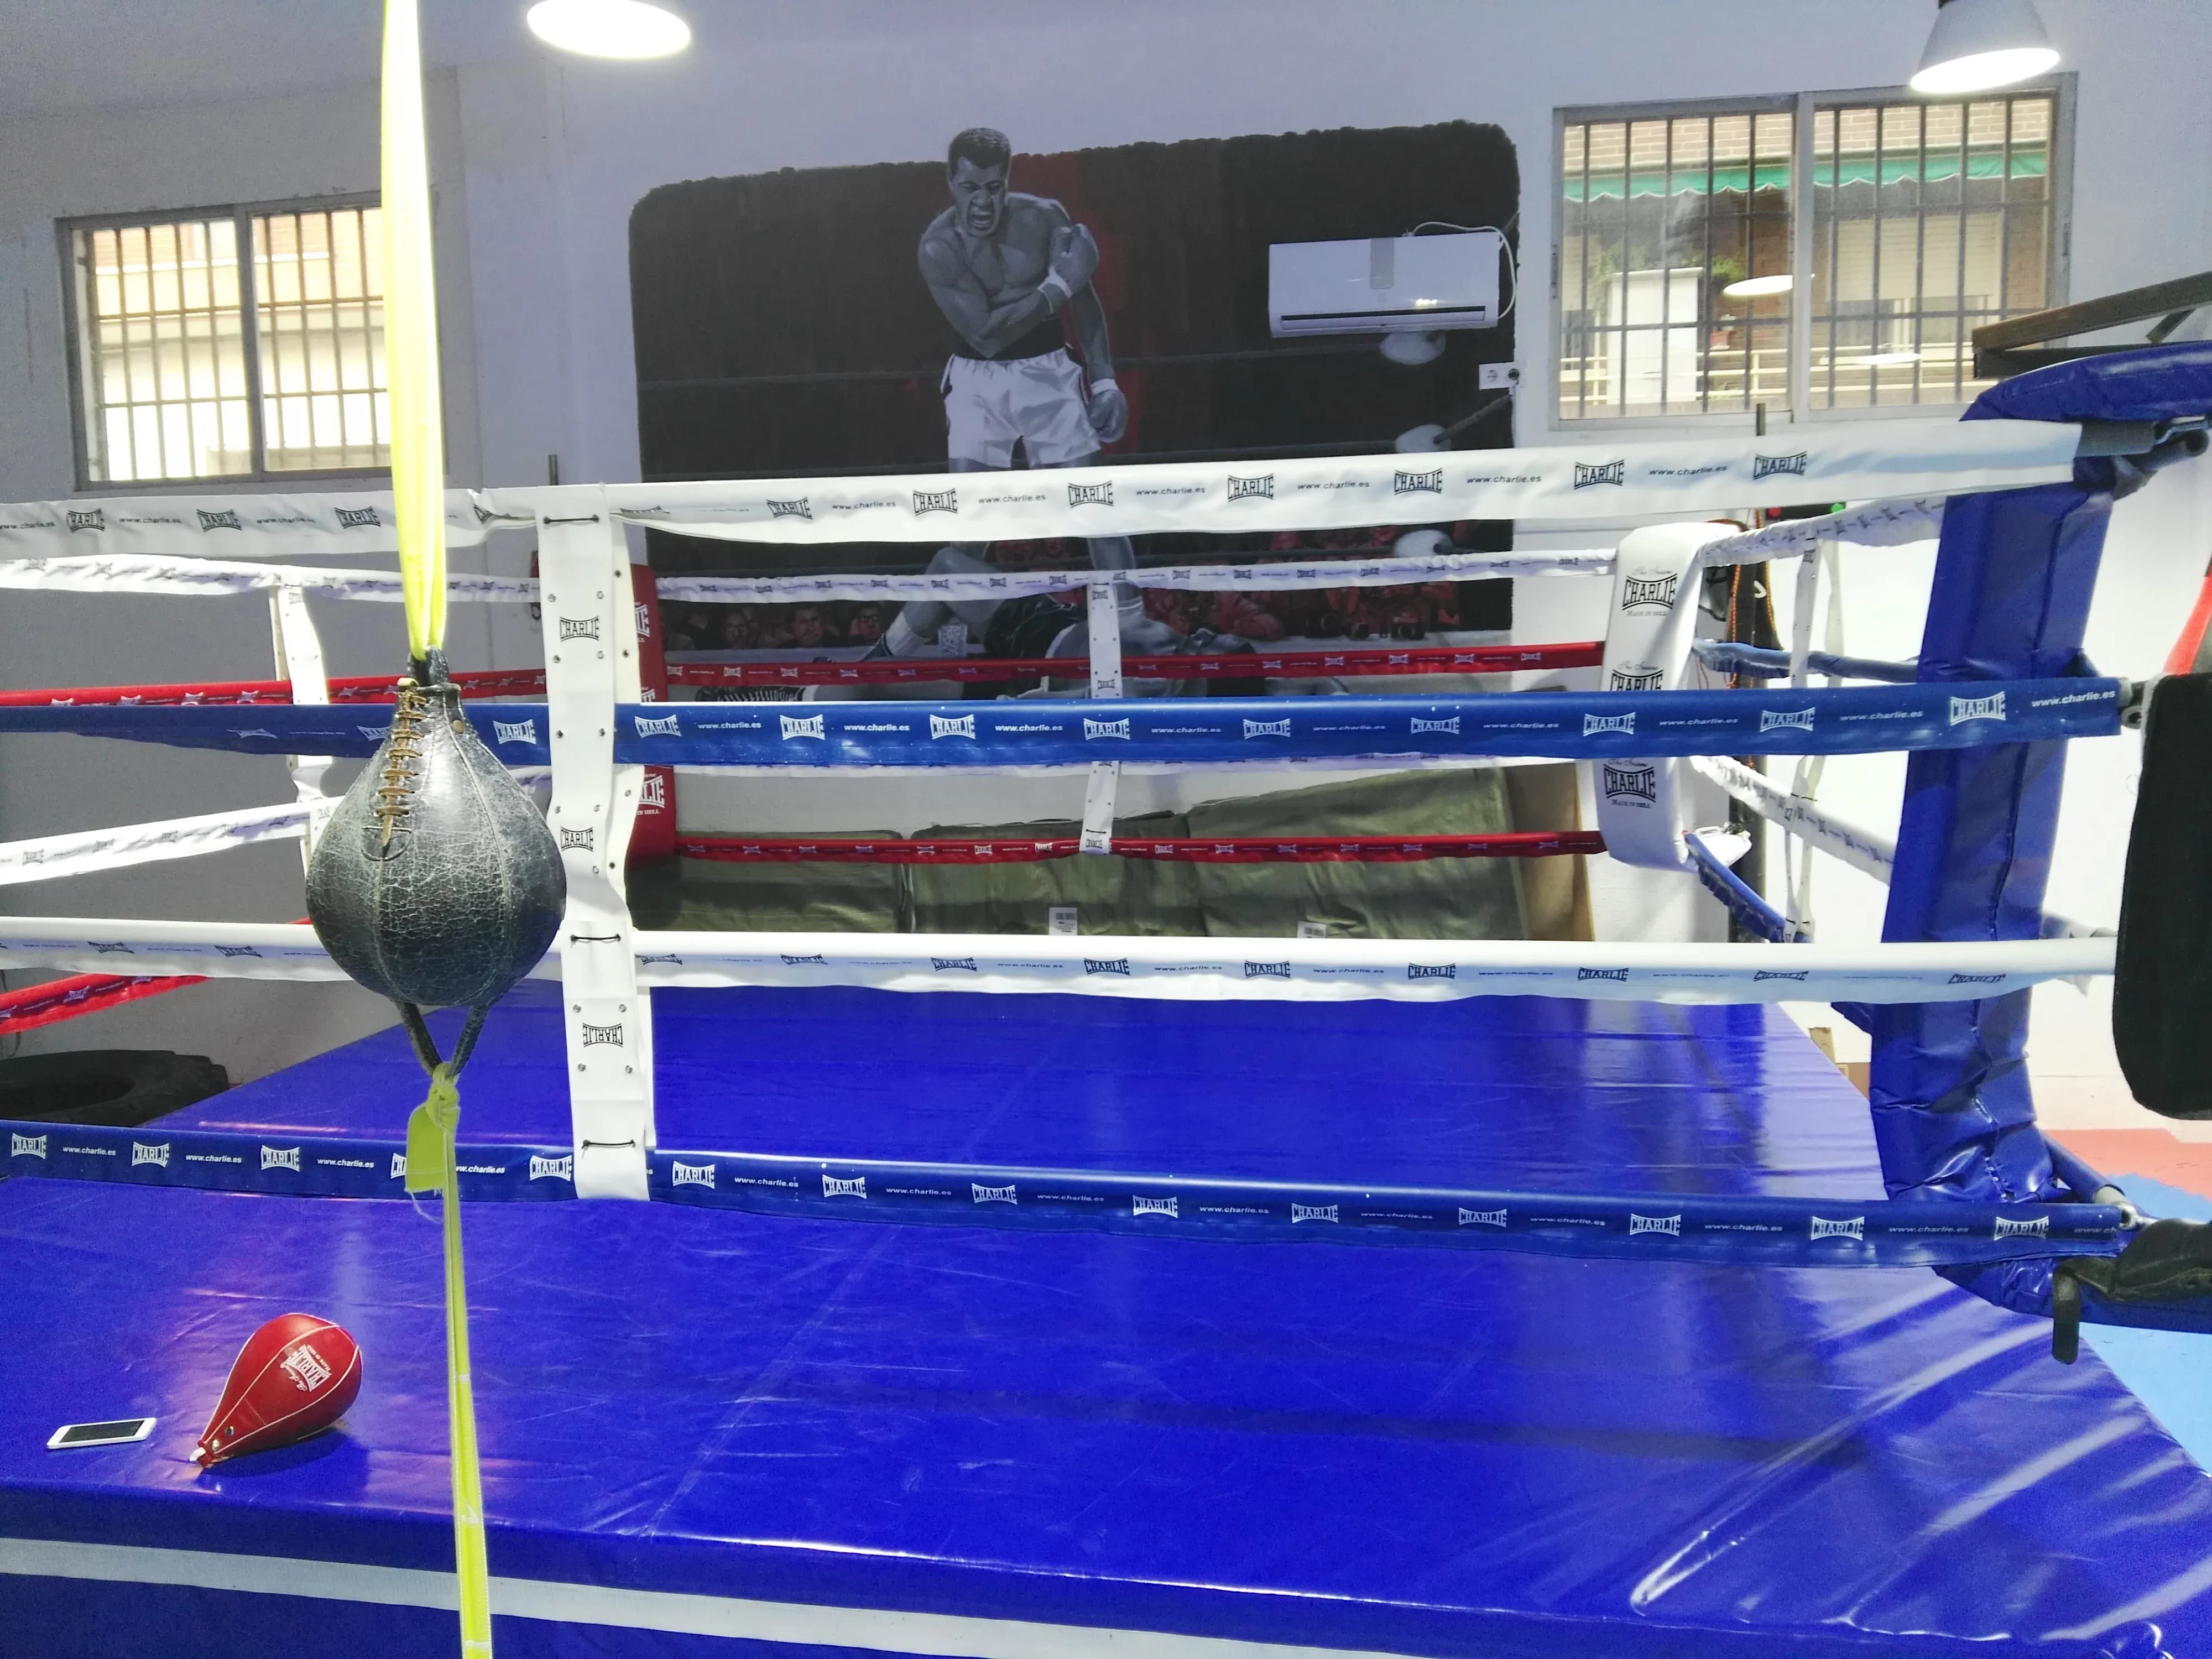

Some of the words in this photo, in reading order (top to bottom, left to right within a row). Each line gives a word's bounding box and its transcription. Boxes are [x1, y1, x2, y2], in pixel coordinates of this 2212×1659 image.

[767, 499, 812, 518] CHARLIE
[832, 500, 895, 510] www.charlie.es
[913, 490, 957, 514] CHARLIE
[978, 493, 1046, 504] www.charlie.es
[1068, 482, 1113, 507] CHARLIE
[1136, 487, 1205, 495] www.charlie.es
[1228, 476, 1274, 499] CHARLIE
[1297, 480, 1370, 490] www.charlie.es
[1394, 469, 1442, 493] CHARLIE
[1467, 474, 1541, 484] www.charlie.es
[1574, 461, 1624, 488] CHARLIE
[1649, 465, 1728, 476] www.charlie.es
[1753, 453, 1807, 478] CHARLIE
[197, 510, 241, 529] CHARLIE
[335, 508, 380, 526] CHARLIE
[1623, 577, 1677, 607] CHARLIE
[560, 618, 599, 640] CHARLIE
[635, 716, 681, 737] CHARLIE
[780, 716, 825, 739] CHARLIE
[844, 723, 910, 732] www.charlie.es
[930, 716, 975, 738] CHARLIE
[1084, 719, 1130, 739] CHARLIE
[1243, 719, 1291, 738] CHARLIE
[1411, 718, 1459, 733] CHARLIE
[1583, 713, 1635, 735] CHARLIE
[1760, 708, 1815, 732] CHARLIE
[1840, 709, 1923, 721] www.charlie.es
[1950, 693, 2006, 724] CHARLIE
[2031, 690, 2116, 707] www.charlie.es
[494, 721, 536, 744] CHARLIE
[1604, 767, 1656, 799] CHARLIE
[561, 829, 593, 850] CHARLIE
[931, 958, 977, 971] CHARLIE
[1084, 959, 1130, 975] CHARLIE
[1244, 962, 1290, 977] CHARLIE
[1408, 964, 1456, 978] CHARLIE
[1578, 968, 1629, 981] CHARLIE
[583, 1025, 623, 1045] CHARLIE
[11, 1134, 46, 1157] CHARLIE
[62, 1146, 116, 1156] www.charlie.es
[132, 1142, 169, 1166] CHARLIE
[185, 1153, 242, 1163] www.charlie.es
[260, 1147, 300, 1171] CHARLIE
[317, 1158, 374, 1168] www.charlie.es
[529, 1156, 572, 1180] CHARLIE
[672, 1162, 715, 1187] CHARLIE
[734, 1177, 799, 1187] www.charlie.es
[822, 1176, 867, 1198] CHARLIE
[886, 1187, 951, 1196] www.charlie.es
[972, 1185, 1018, 1204] CHARLIE
[1037, 1193, 1104, 1202] www.charlie.es
[1133, 1196, 1178, 1217] CHARLIE
[1199, 1206, 1269, 1214] www.charlie.es
[1292, 1204, 1338, 1222] CHARLIE
[1459, 1209, 1507, 1227] CHARLIE
[1531, 1217, 1605, 1225] www.charlie.es
[1630, 1215, 1681, 1235] CHARLIE
[1704, 1223, 1783, 1232] www.charlie.es
[1811, 1218, 1865, 1240] CHARLIE
[1994, 1218, 2048, 1240] CHARLIE
[285, 1345, 331, 1391] CHARLIE
